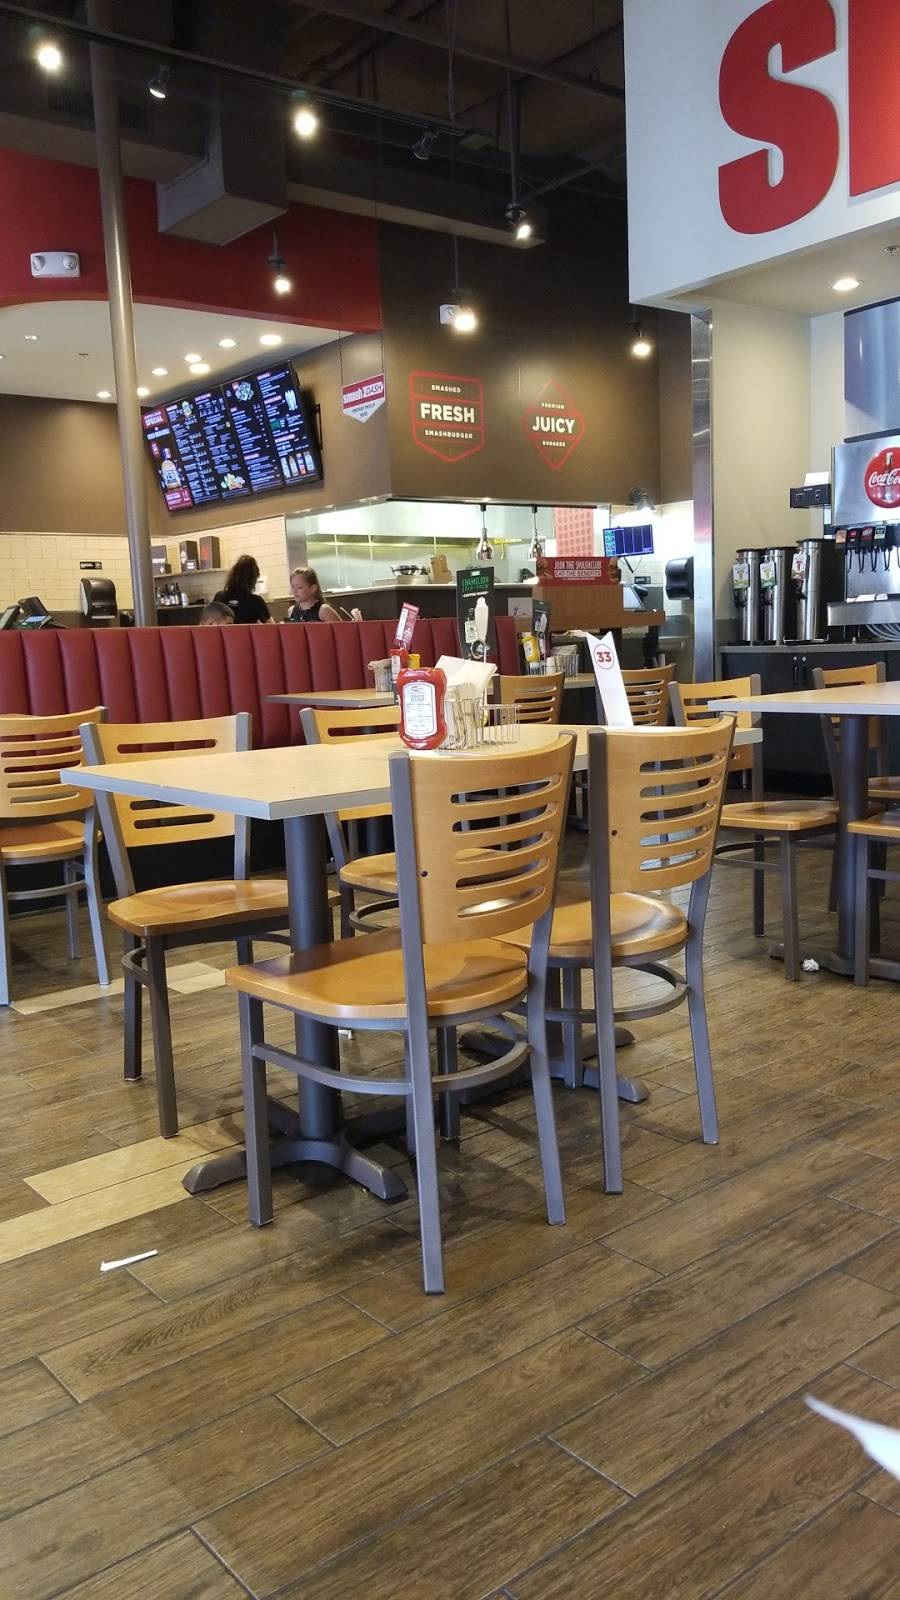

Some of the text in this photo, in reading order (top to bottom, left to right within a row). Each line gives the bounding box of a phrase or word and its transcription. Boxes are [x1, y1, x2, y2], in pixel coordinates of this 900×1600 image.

[365, 383, 382, 395] DASH
[431, 384, 461, 393] SMASHED
[420, 403, 475, 423] FRESH
[532, 416, 575, 434] JUICY
[425, 429, 473, 439] SMASHBURGER
[868, 468, 900, 488] Coca-Co
[554, 560, 602, 569] JOIN THE SMASHCLUB
[596, 651, 612, 662] 33
